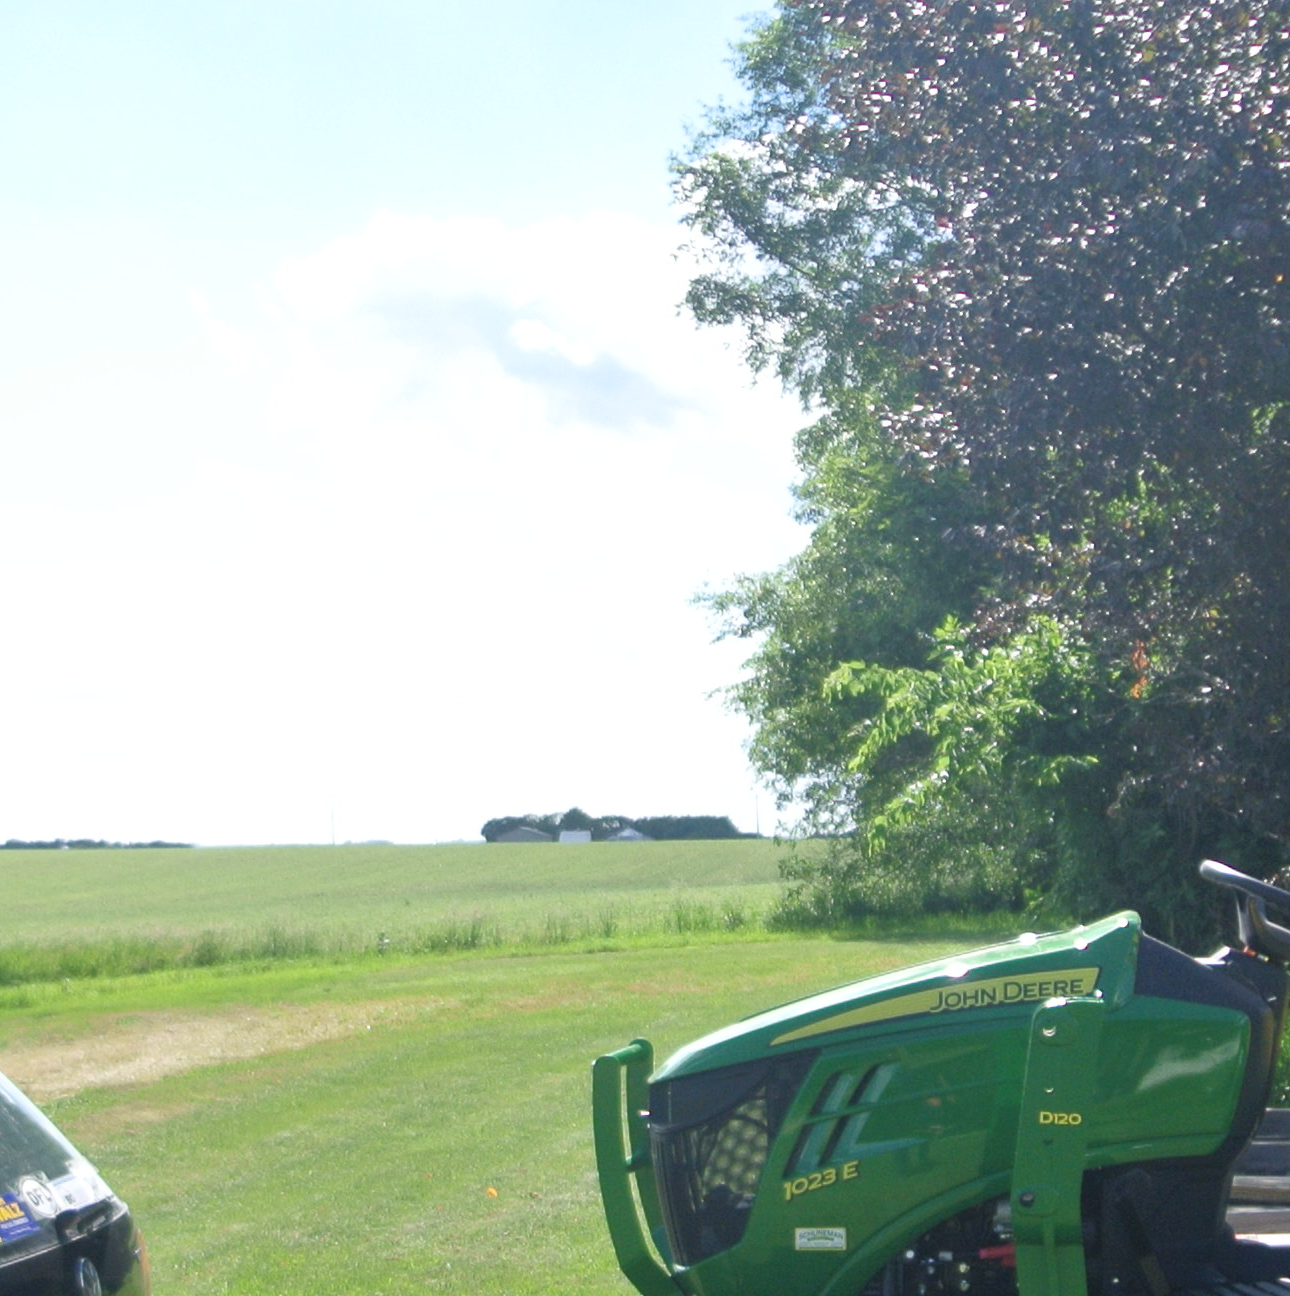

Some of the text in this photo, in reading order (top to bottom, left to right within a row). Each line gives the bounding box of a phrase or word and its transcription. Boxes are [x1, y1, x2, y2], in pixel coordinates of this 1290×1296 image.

[930, 979, 1084, 1012] JOHN DEERE
[1039, 1111, 1082, 1125] D120
[784, 1160, 859, 1201] 1023 E
